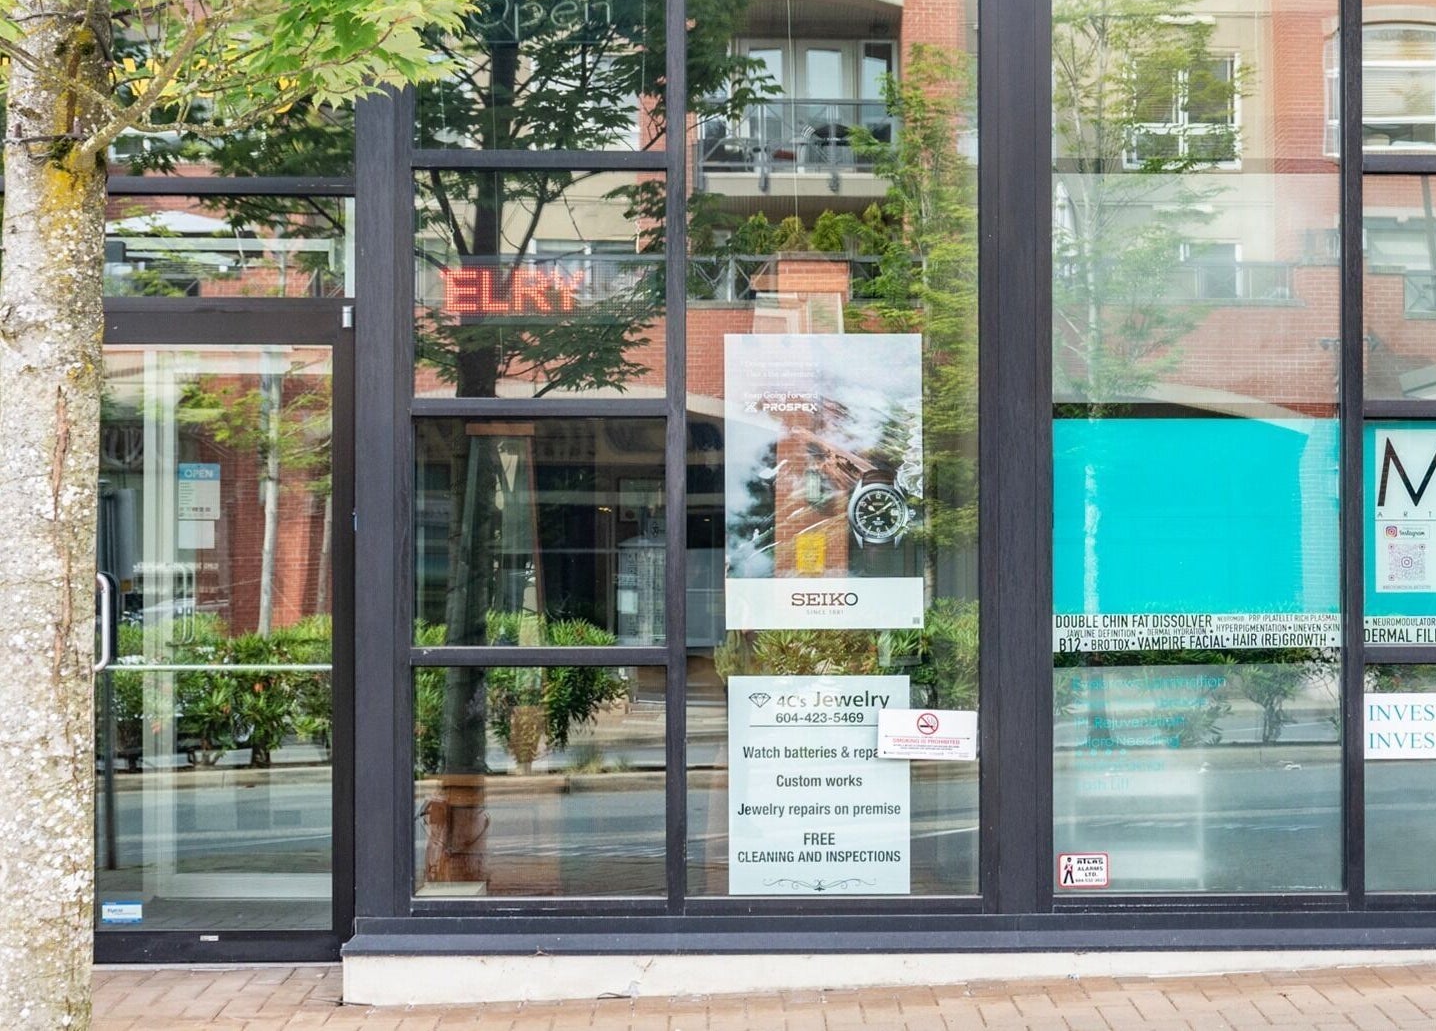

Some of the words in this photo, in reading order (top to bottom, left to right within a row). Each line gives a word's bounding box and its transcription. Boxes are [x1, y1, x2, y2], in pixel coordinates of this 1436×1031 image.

[764, 390, 786, 402] Going
[762, 402, 819, 414] PROSPEX
[791, 592, 859, 607] SEIKO
[1056, 615, 1099, 628] DOUBLE
[1102, 615, 1128, 628] CHIN
[1132, 615, 1149, 628] FAT
[1152, 615, 1212, 628] DISSOLVER
[1216, 623, 1287, 633] HYPERPIGMENTATION
[1293, 623, 1321, 632] UNEVEN
[1323, 623, 1341, 633] SKIN
[1372, 617, 1436, 627] NEUROMODULATOR
[1066, 630, 1096, 638] JAWLINE
[1098, 629, 1136, 638] DEFINITION
[1363, 628, 1413, 643] DERMAL
[1059, 638, 1081, 653] B12
[1138, 636, 1187, 650] VAMPIRE
[1189, 635, 1227, 648] FACIAL
[1232, 633, 1257, 646] HAIR
[1261, 633, 1327, 647] (RE)GROWTH
[812, 690, 891, 710] Jewelry
[775, 712, 865, 724] 604-423-5469
[743, 746, 782, 759] Watch
[784, 746, 838, 759] batteries
[841, 746, 852, 759] &
[853, 748, 879, 761] repa
[776, 774, 822, 787] Custom
[825, 774, 863, 787] works
[737, 803, 785, 818] Jewelry
[788, 803, 831, 818] repairs
[834, 805, 849, 816] on
[853, 804, 902, 818] premise
[803, 833, 836, 846] FREE
[738, 851, 795, 863] CLEANING
[798, 851, 823, 863] AND
[826, 851, 902, 863] INSPECTIONS
